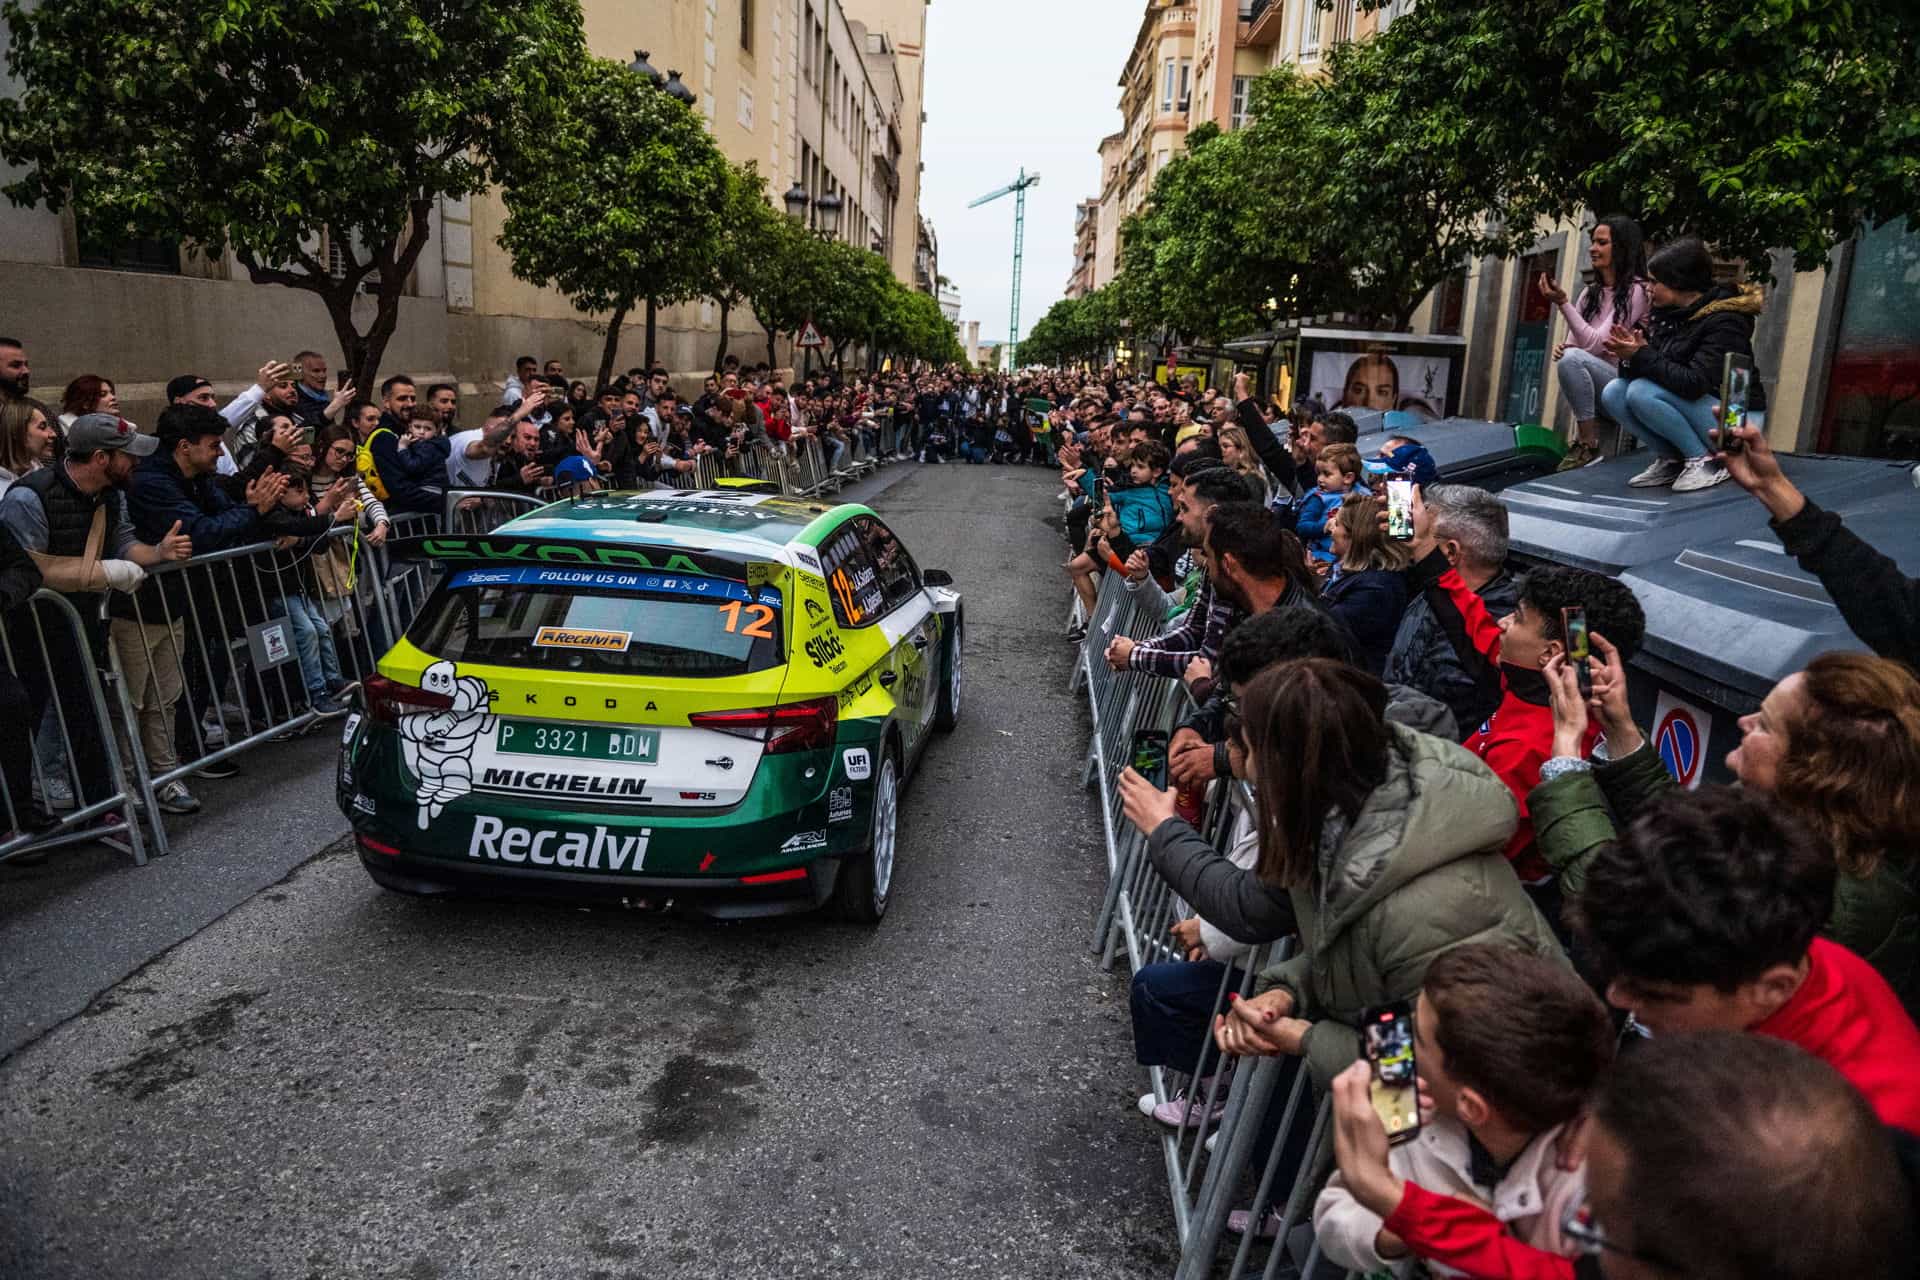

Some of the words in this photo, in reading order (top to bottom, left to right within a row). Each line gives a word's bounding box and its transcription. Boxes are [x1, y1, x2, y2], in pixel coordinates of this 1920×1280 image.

[539, 571, 594, 582] FOLLOW
[596, 574, 614, 583] US
[618, 576, 638, 585] ON
[832, 567, 862, 625] 12
[719, 600, 776, 639] 12
[554, 632, 610, 646] Recalvi
[503, 725, 514, 746] P
[535, 727, 588, 753] 3321
[848, 755, 867, 766] UFI
[483, 767, 647, 795] MICHELIN
[468, 815, 651, 872] Recalvi
